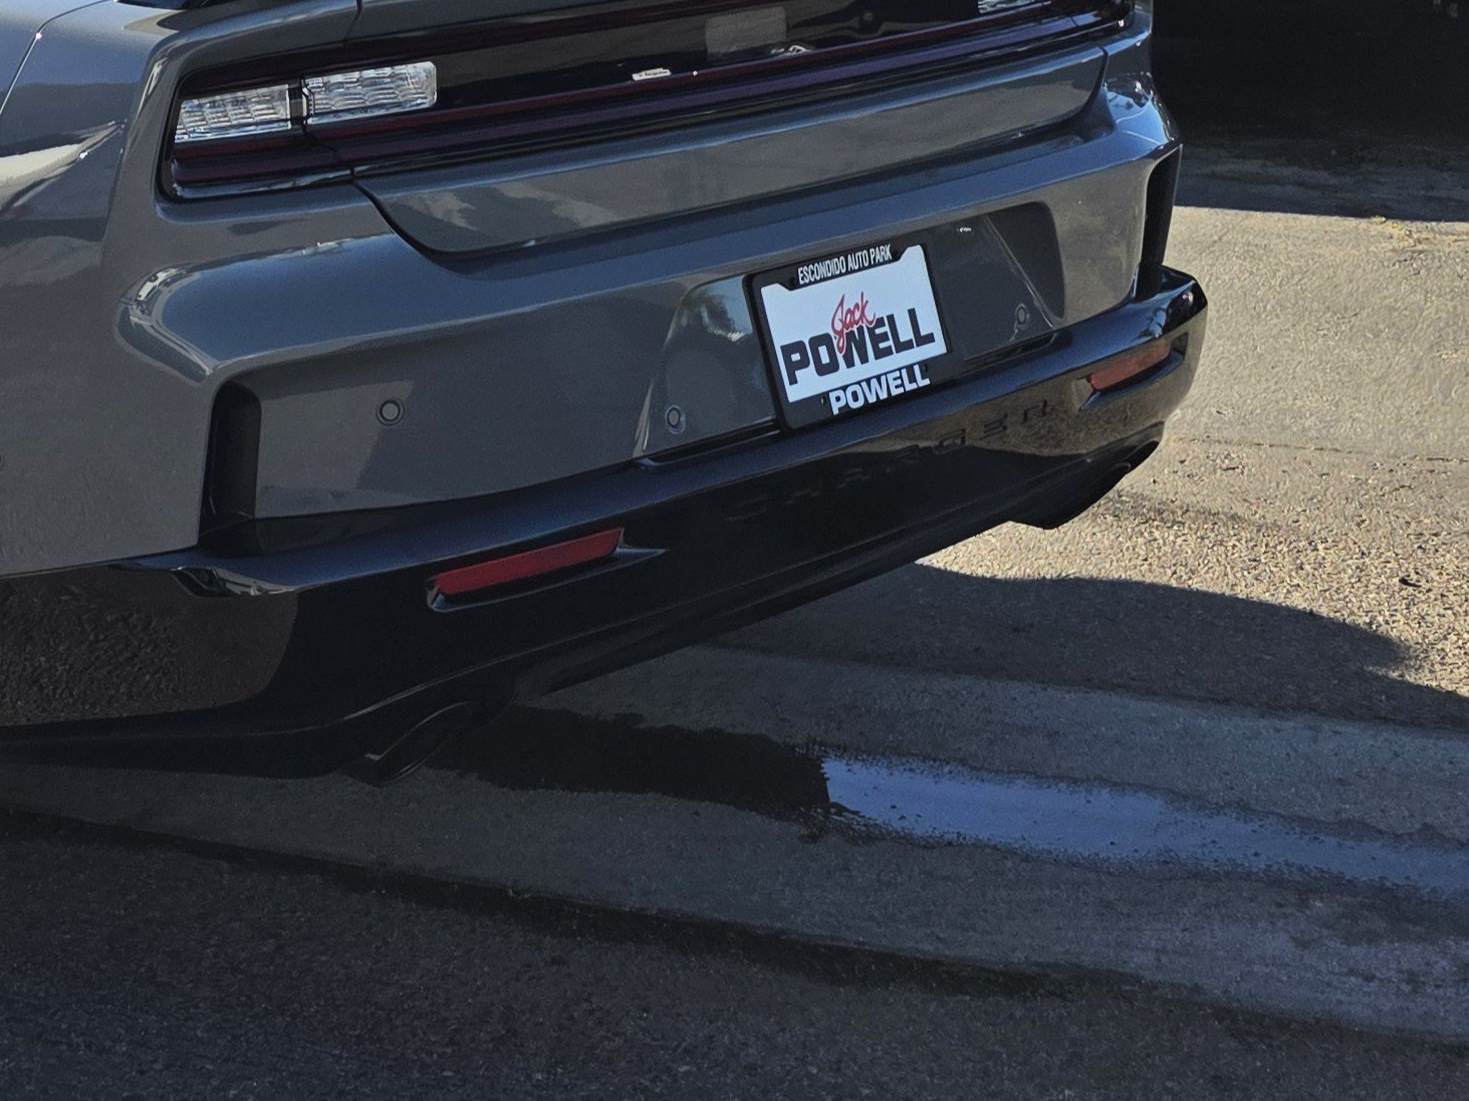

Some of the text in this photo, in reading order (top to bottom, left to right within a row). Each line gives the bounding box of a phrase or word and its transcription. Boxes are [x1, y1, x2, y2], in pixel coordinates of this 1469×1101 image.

[797, 243, 893, 286] ESCONDIDO AUTO PARK
[780, 307, 936, 386] POWELL
[831, 290, 876, 355] Jack
[829, 364, 931, 416] POWELL
